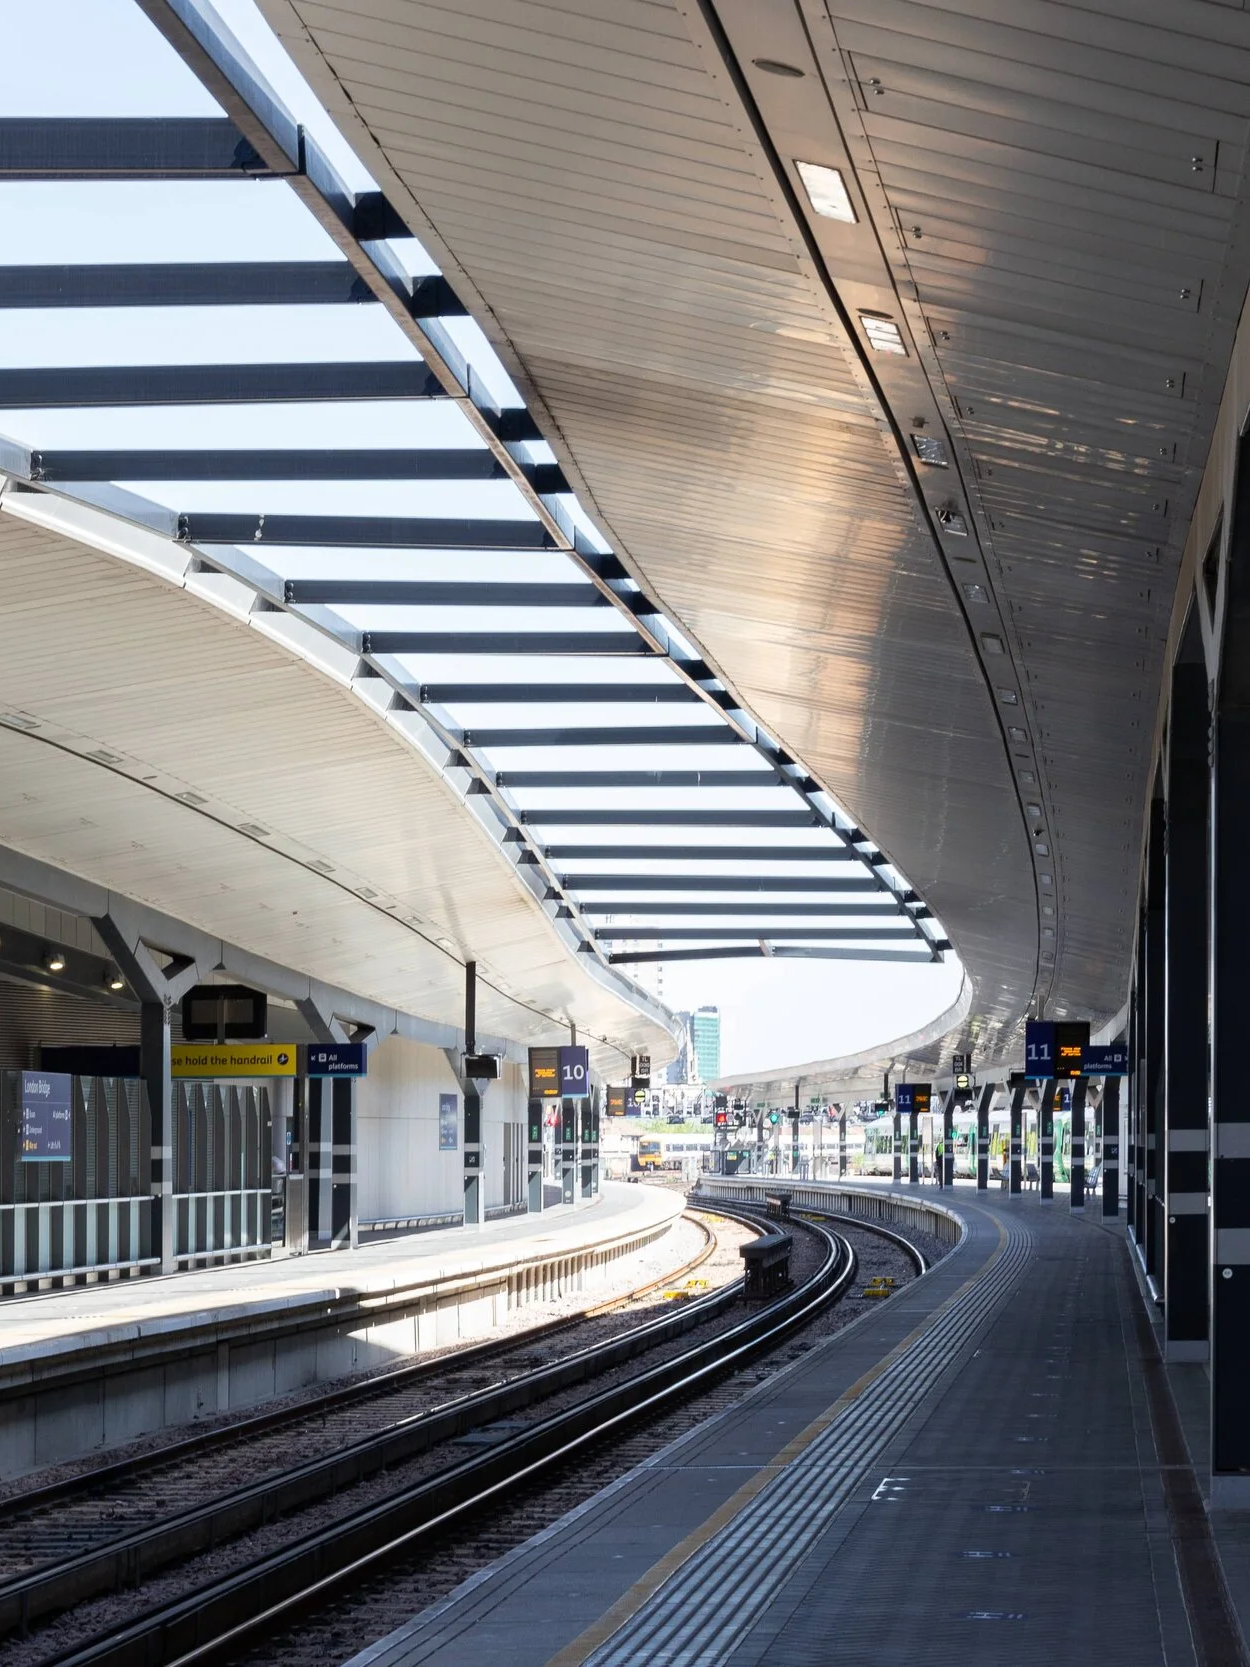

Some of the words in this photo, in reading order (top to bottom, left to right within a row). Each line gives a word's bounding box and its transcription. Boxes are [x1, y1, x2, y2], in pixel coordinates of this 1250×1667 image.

[1027, 1043, 1051, 1060] 11
[185, 1055, 208, 1065] hold
[210, 1055, 228, 1065] the
[230, 1054, 273, 1065] handrail
[328, 1062, 359, 1071] platforms
[562, 1064, 585, 1080] 10
[898, 1095, 912, 1104] 11
